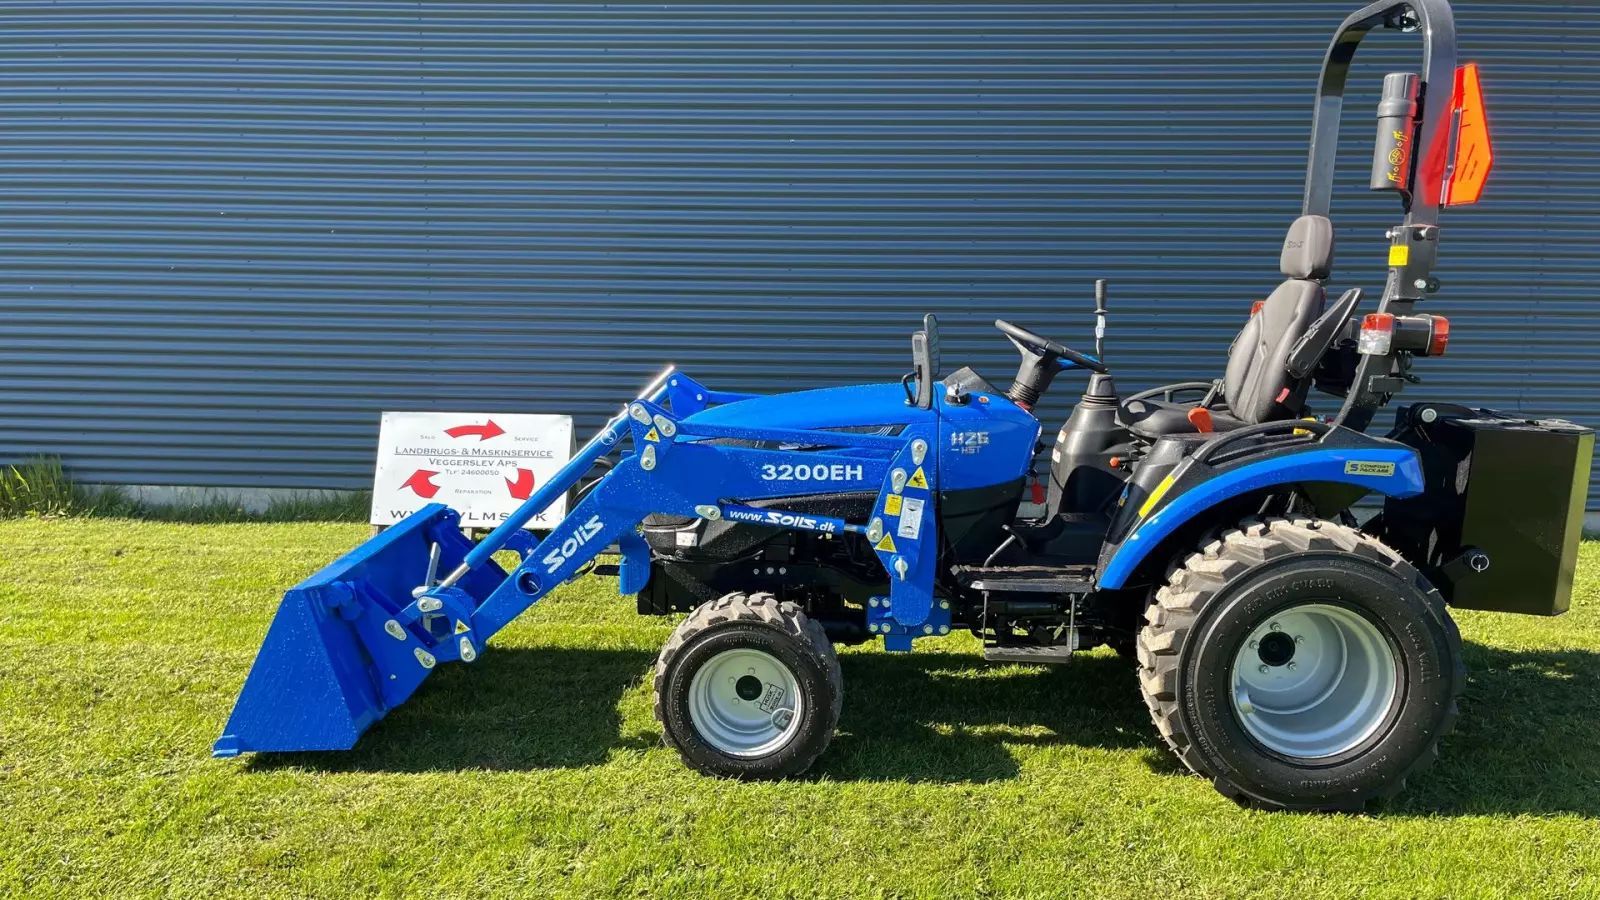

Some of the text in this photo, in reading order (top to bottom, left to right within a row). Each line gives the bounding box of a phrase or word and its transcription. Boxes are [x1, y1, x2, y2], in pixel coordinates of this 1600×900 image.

[461, 447, 469, 455] &
[472, 448, 553, 457] MASKINSERVICE
[429, 458, 518, 468] VEGGERSLEV APS
[761, 464, 863, 481] 3200EH
